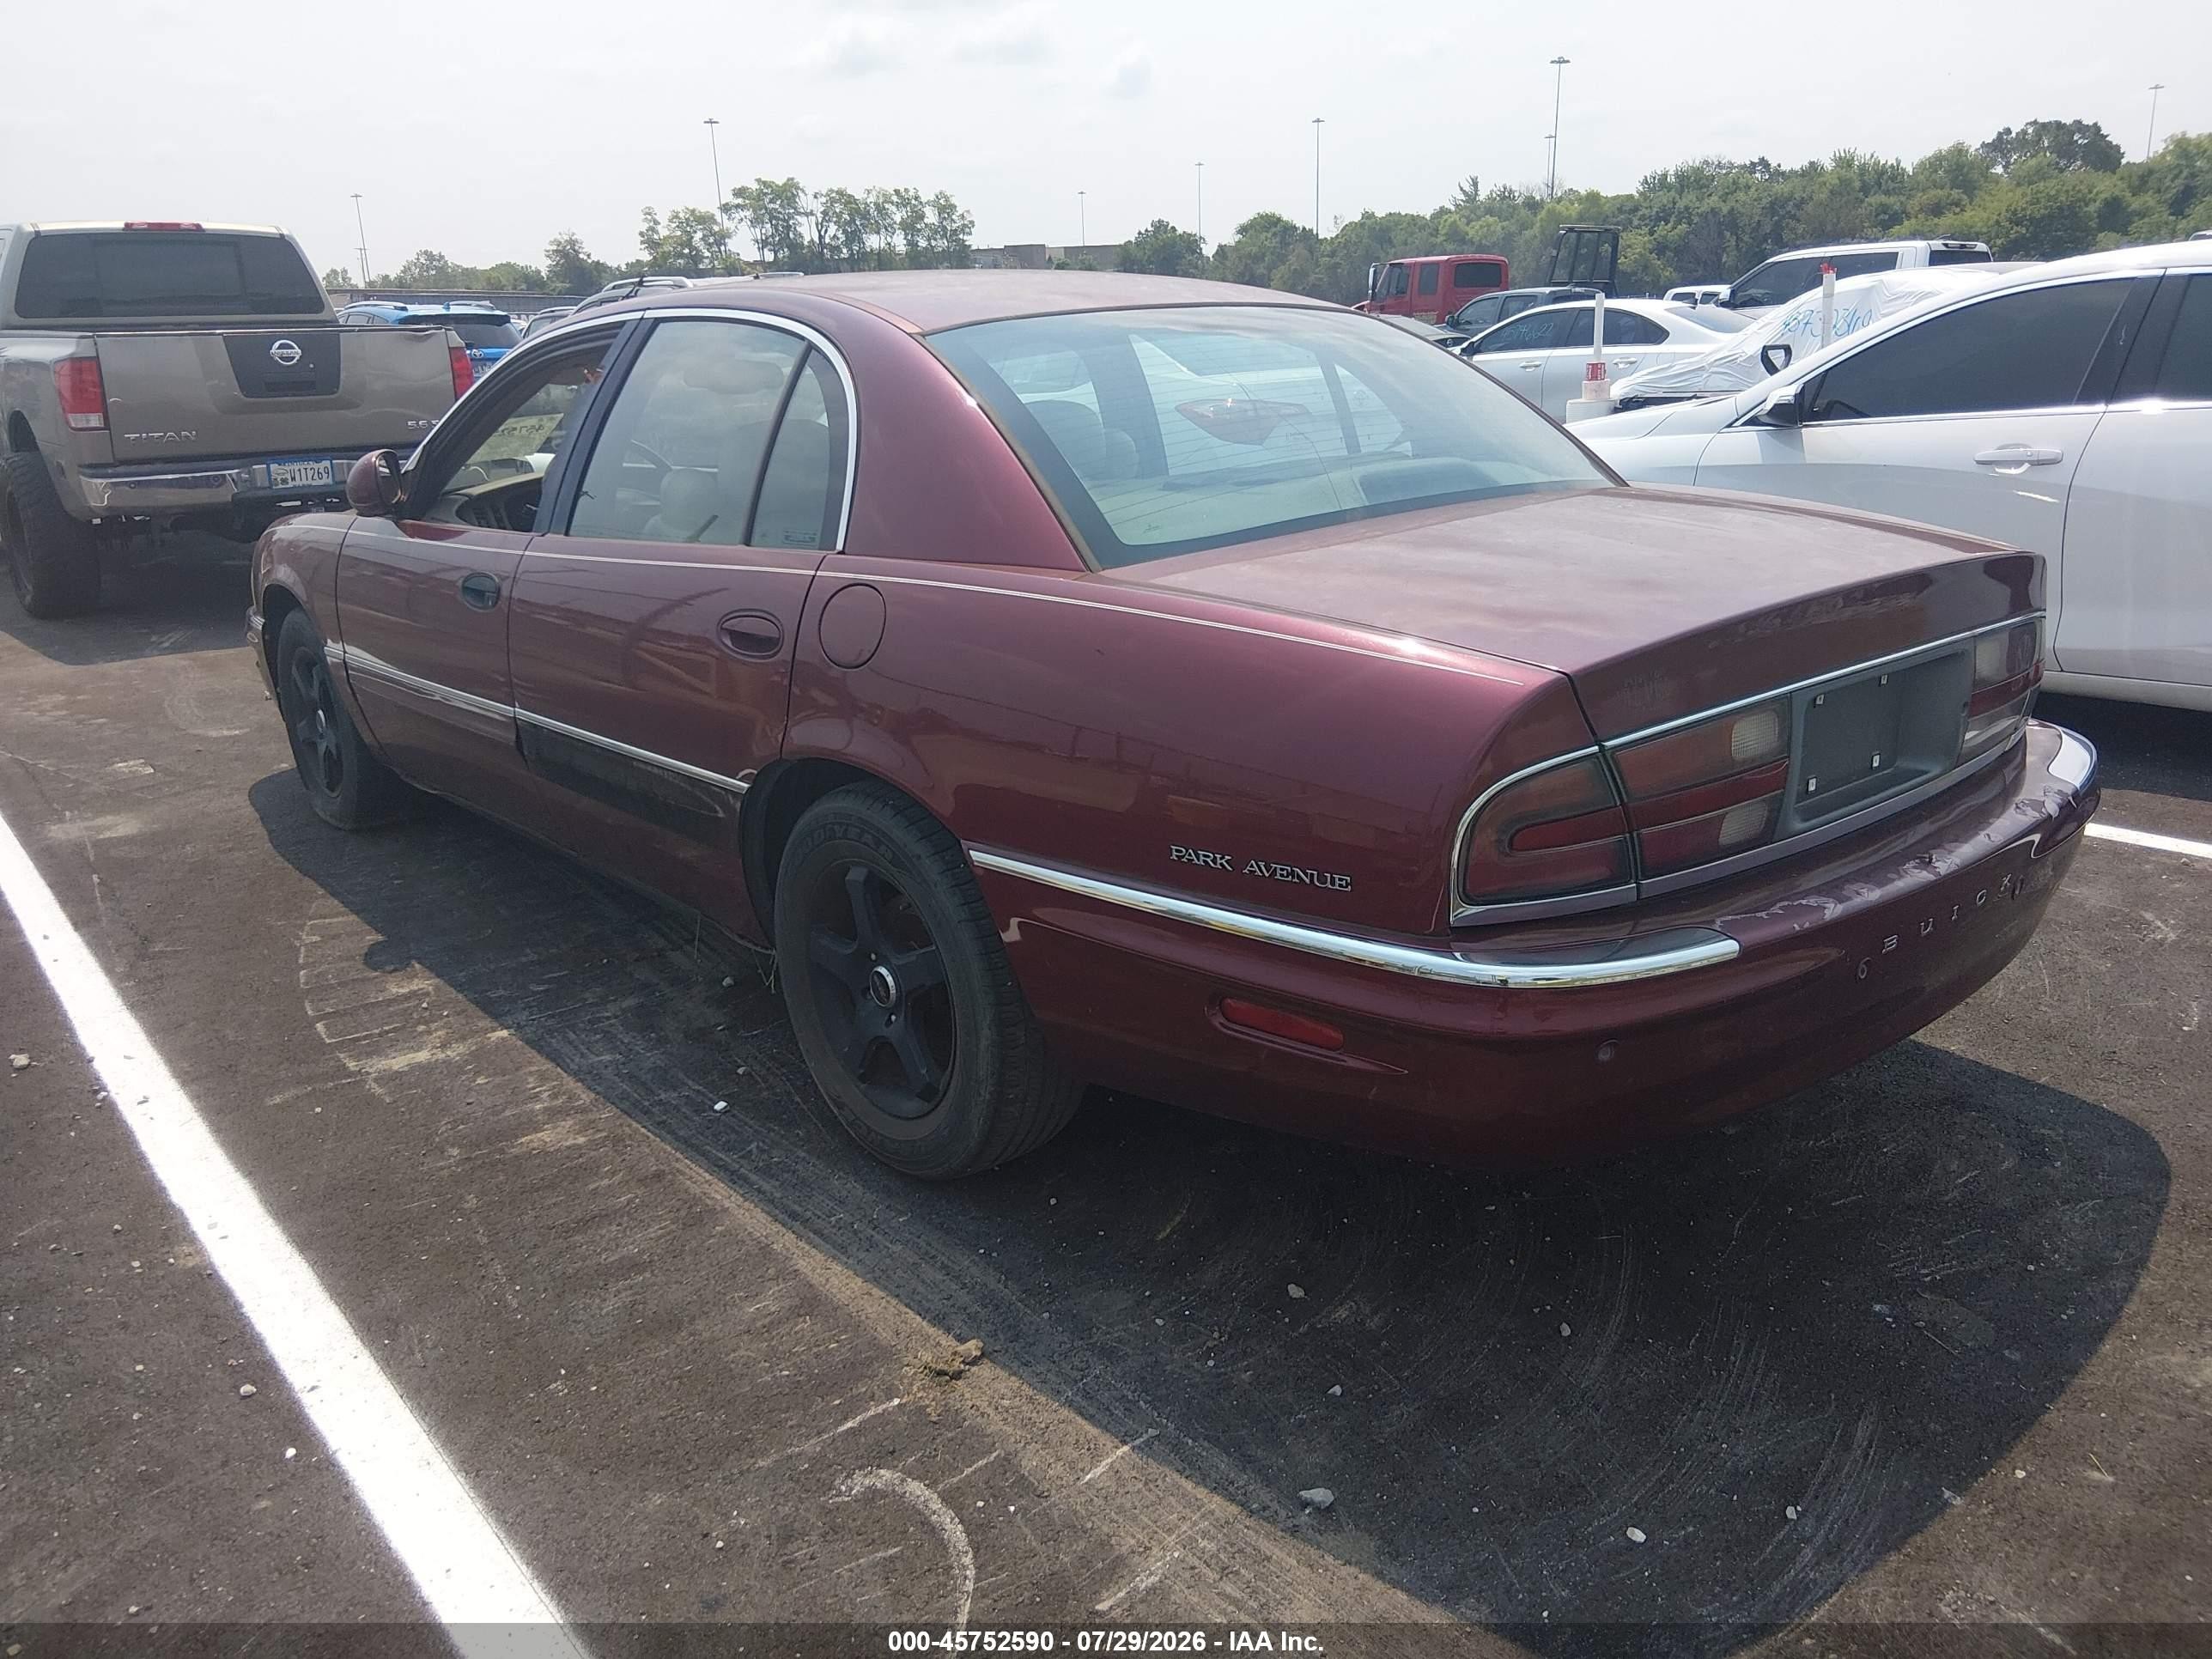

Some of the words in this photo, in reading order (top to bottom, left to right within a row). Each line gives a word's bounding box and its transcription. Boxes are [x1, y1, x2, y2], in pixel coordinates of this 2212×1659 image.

[124, 431, 197, 444] TITAN
[289, 466, 330, 482] W1T269
[1170, 845, 1234, 872] PARK
[1242, 860, 1352, 892] AVENUE
[1881, 873, 2012, 955] BUICK
